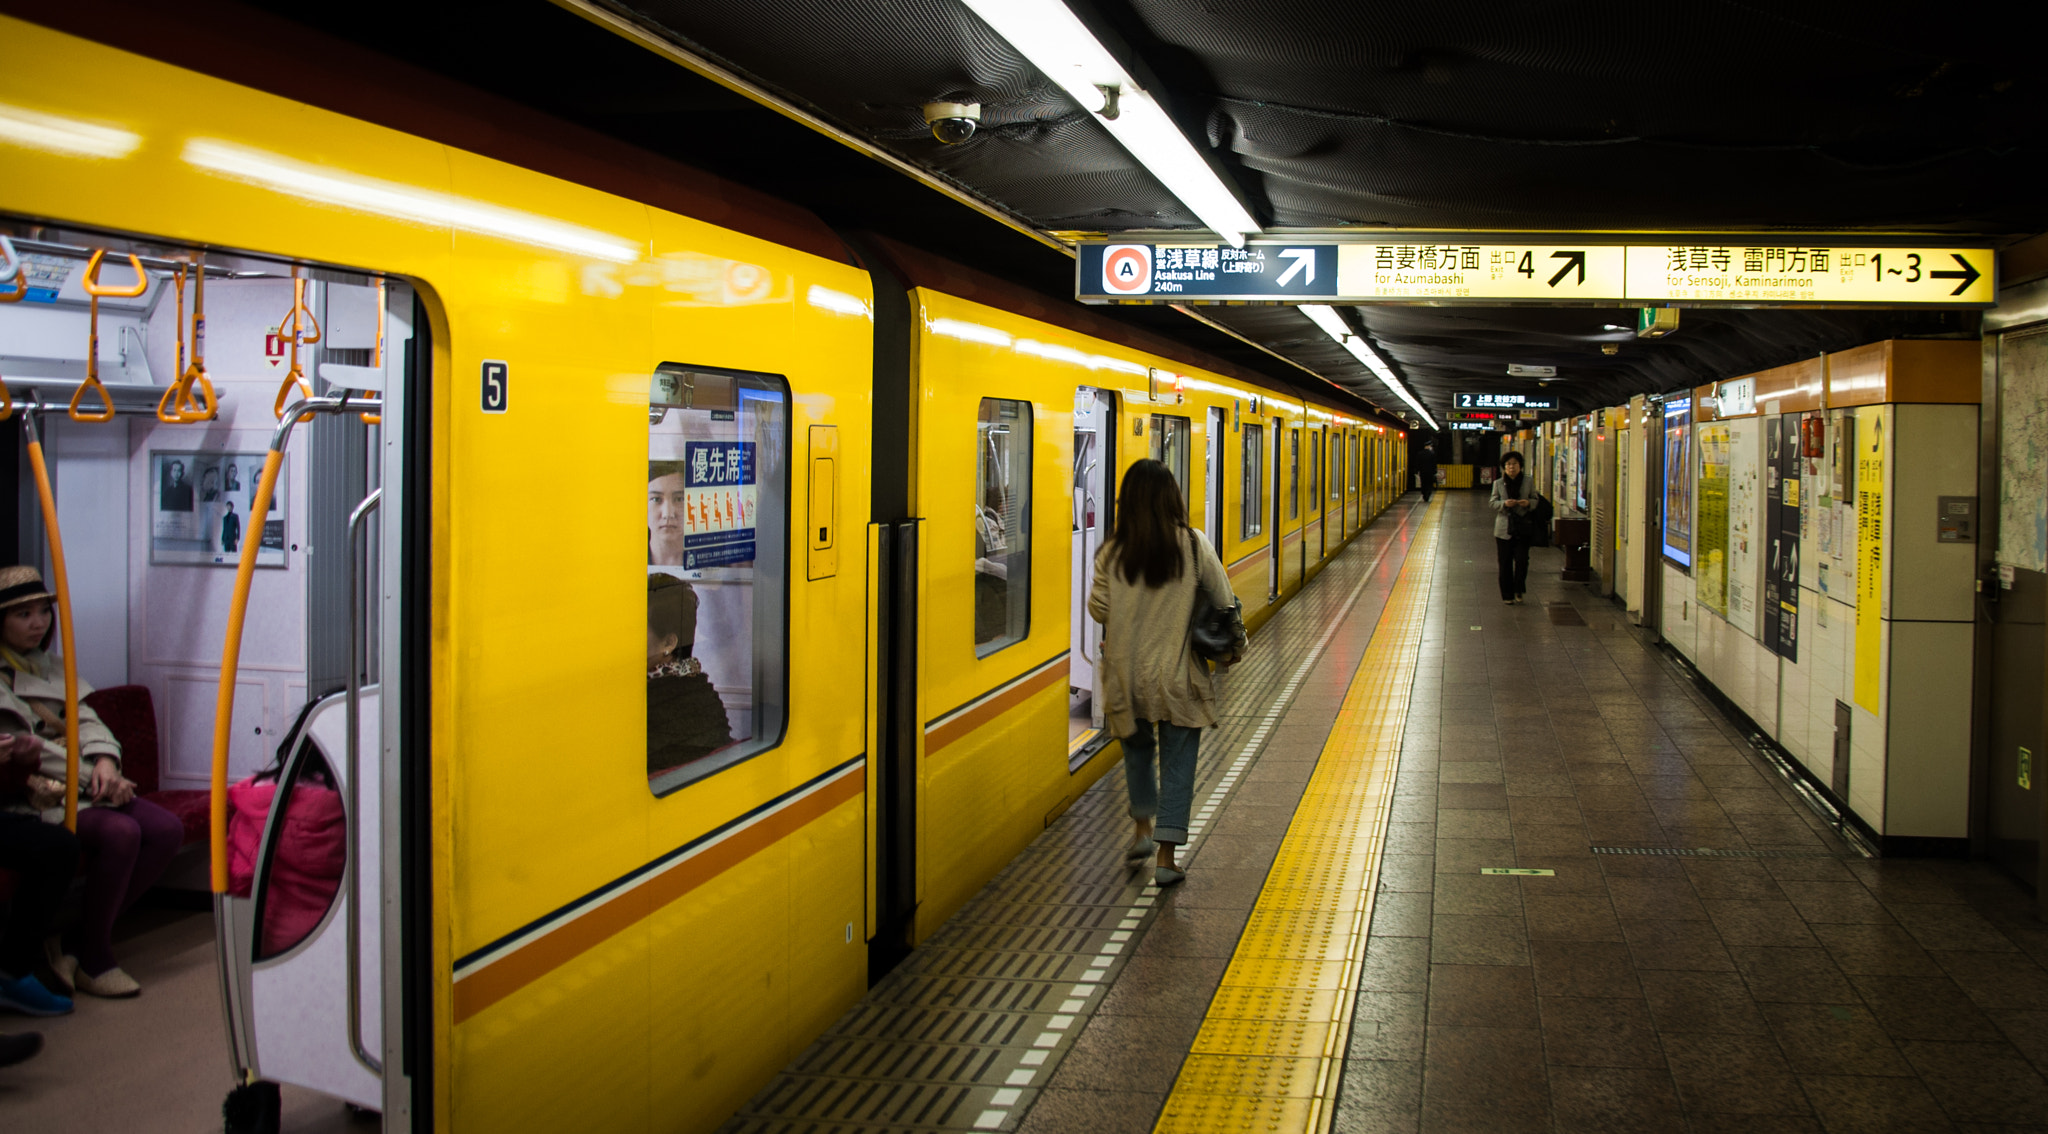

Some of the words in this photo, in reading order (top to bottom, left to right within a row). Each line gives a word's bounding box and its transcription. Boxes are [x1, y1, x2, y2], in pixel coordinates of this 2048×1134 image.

[1166, 248, 1219, 269] 浅草線
[1221, 249, 1265, 260] 反対ホーム
[1375, 245, 1480, 270] 吾妻橋方面
[1667, 246, 1731, 272] 浅草寺
[1744, 246, 1830, 273] 雷門方面
[1840, 253, 1865, 266] 出口
[1120, 262, 1133, 276] A
[1490, 250, 1515, 264] 出口
[1518, 251, 1535, 279] 4
[1154, 270, 1193, 280] Asakusa
[1195, 270, 1215, 280] Line
[1375, 272, 1391, 285] for
[1395, 273, 1464, 285] Azumabashi
[1667, 274, 1683, 286] for
[1687, 274, 1732, 289] Sensoji,
[1735, 275, 1813, 287] Kaminarimon
[1154, 282, 1183, 292] 240m
[488, 367, 501, 408] 5
[1462, 395, 1471, 407] 2
[691, 447, 741, 484] 優先席
